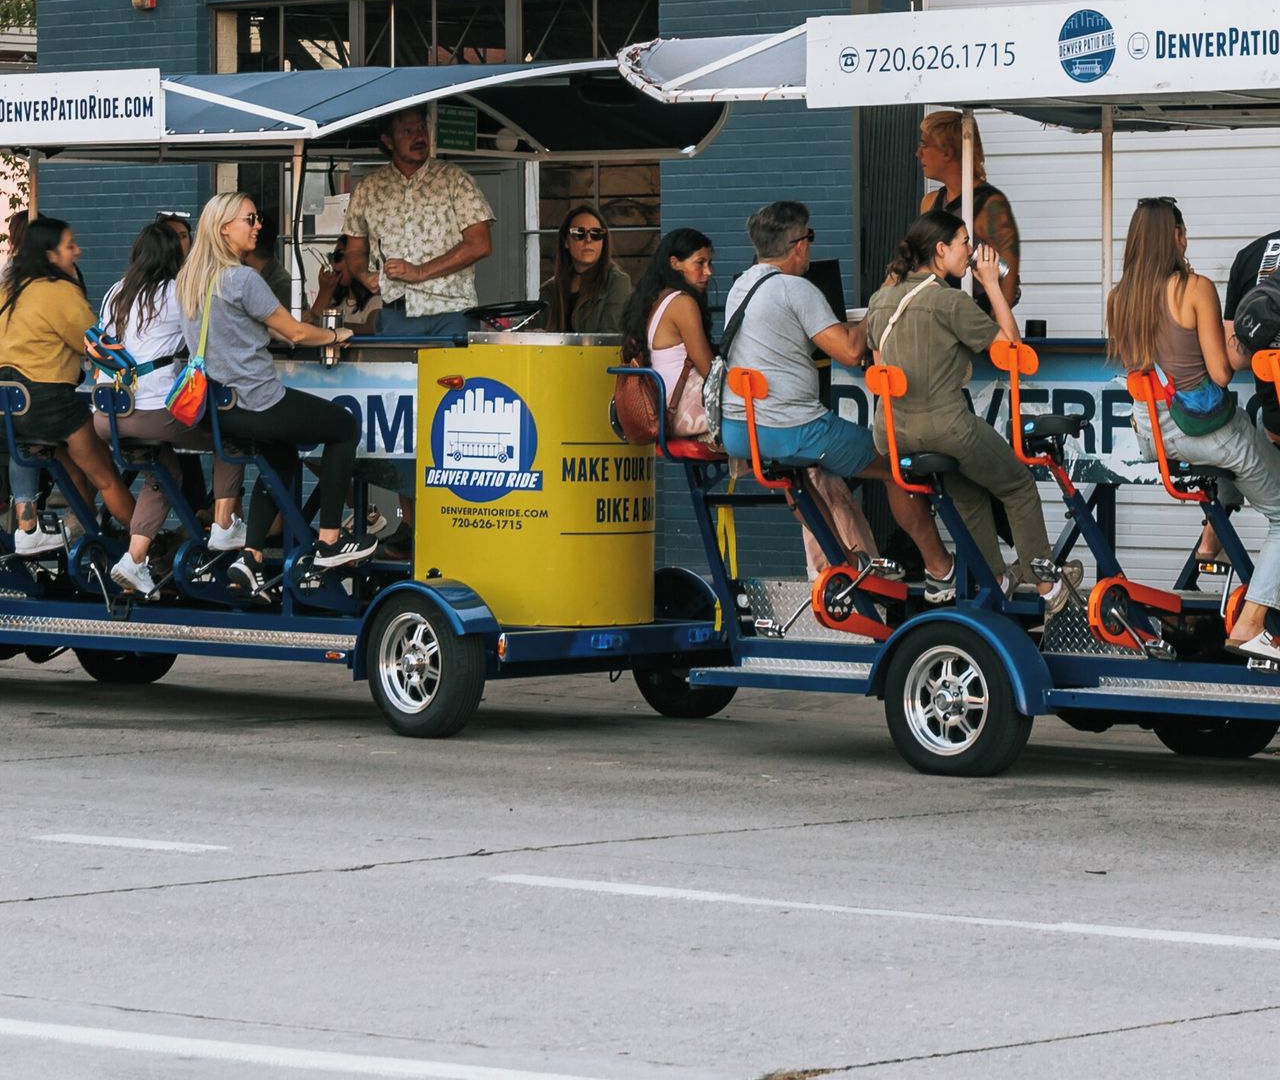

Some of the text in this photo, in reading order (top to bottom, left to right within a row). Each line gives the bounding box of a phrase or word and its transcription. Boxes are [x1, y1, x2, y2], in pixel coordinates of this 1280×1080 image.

[865, 41, 1016, 73] 720.626.1715
[1059, 33, 1114, 57] DENVER PATIO RIDE
[427, 469, 539, 488] DENVER PATIO RIDE
[561, 457, 609, 482] MAKE
[614, 457, 644, 482] YOUR
[440, 506, 549, 518] DENVERPATIORIDE.COM
[596, 497, 629, 523] BIKE
[633, 497, 640, 522] A
[452, 518, 522, 530] 720-626-1715
